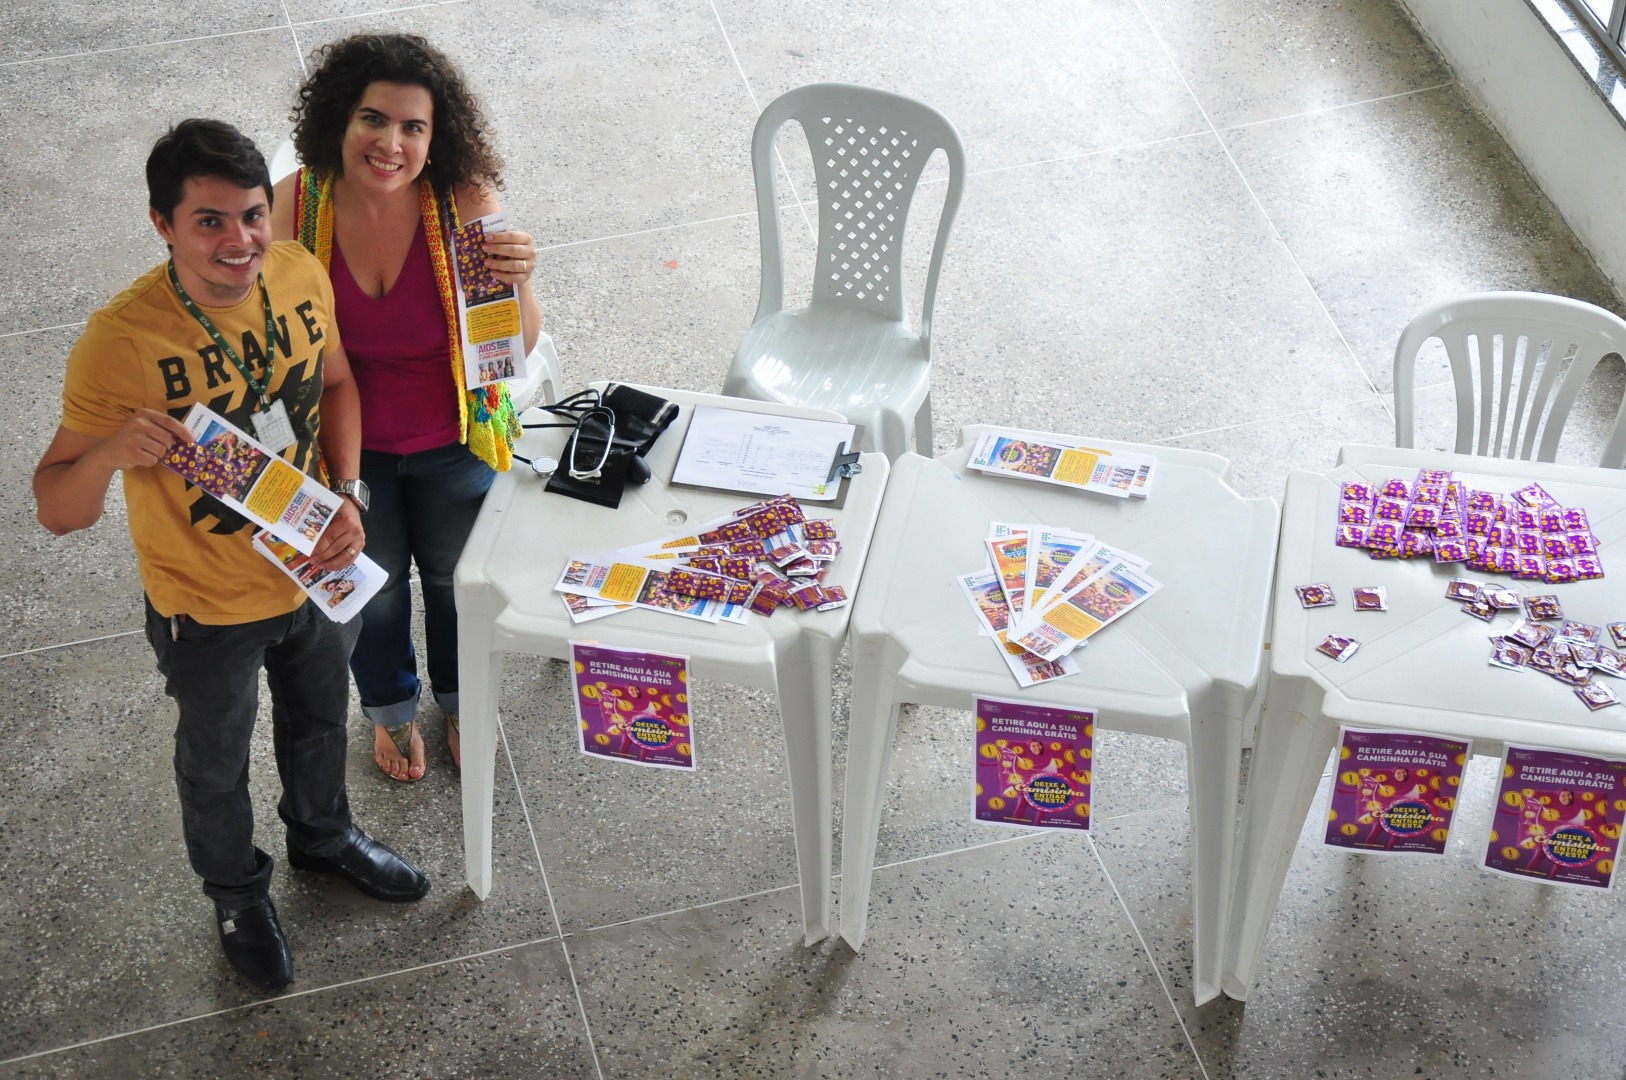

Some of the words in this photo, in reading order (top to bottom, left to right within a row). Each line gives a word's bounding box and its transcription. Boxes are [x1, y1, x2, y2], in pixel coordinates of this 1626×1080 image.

[200, 316, 210, 328] IFCE
[157, 300, 324, 401] BRAVE
[479, 342, 496, 353] AIDS
[283, 503, 298, 523] AIDS
[590, 661, 621, 671] RETIRE
[623, 666, 644, 675] AQUI
[653, 669, 671, 678] SUA
[590, 668, 639, 681] CAMISINHA
[640, 675, 671, 686] GRÁTIS
[992, 718, 1025, 727] RETIRE
[1027, 721, 1048, 730] AQUI
[1050, 723, 1058, 731] A
[1059, 724, 1077, 733] SUA
[992, 725, 1043, 736] CAMISINHA
[1045, 729, 1077, 740] GRÁTIS
[637, 732, 667, 740] ENTRAR
[1358, 747, 1393, 755] RETIRE
[1428, 752, 1448, 760] SUA
[1357, 755, 1410, 763] CAMISINHA
[1412, 755, 1447, 767] GRÁTIS
[1522, 765, 1558, 775] RETIRE
[1560, 769, 1583, 778] AQUI
[1595, 772, 1615, 782] SUA
[1520, 773, 1575, 785] CAMISINHA
[1578, 779, 1614, 790] GRÁTIS
[1556, 833, 1583, 841] DEIXE
[1553, 846, 1589, 854] ENTRAR
[1559, 851, 1587, 860] FESTA
